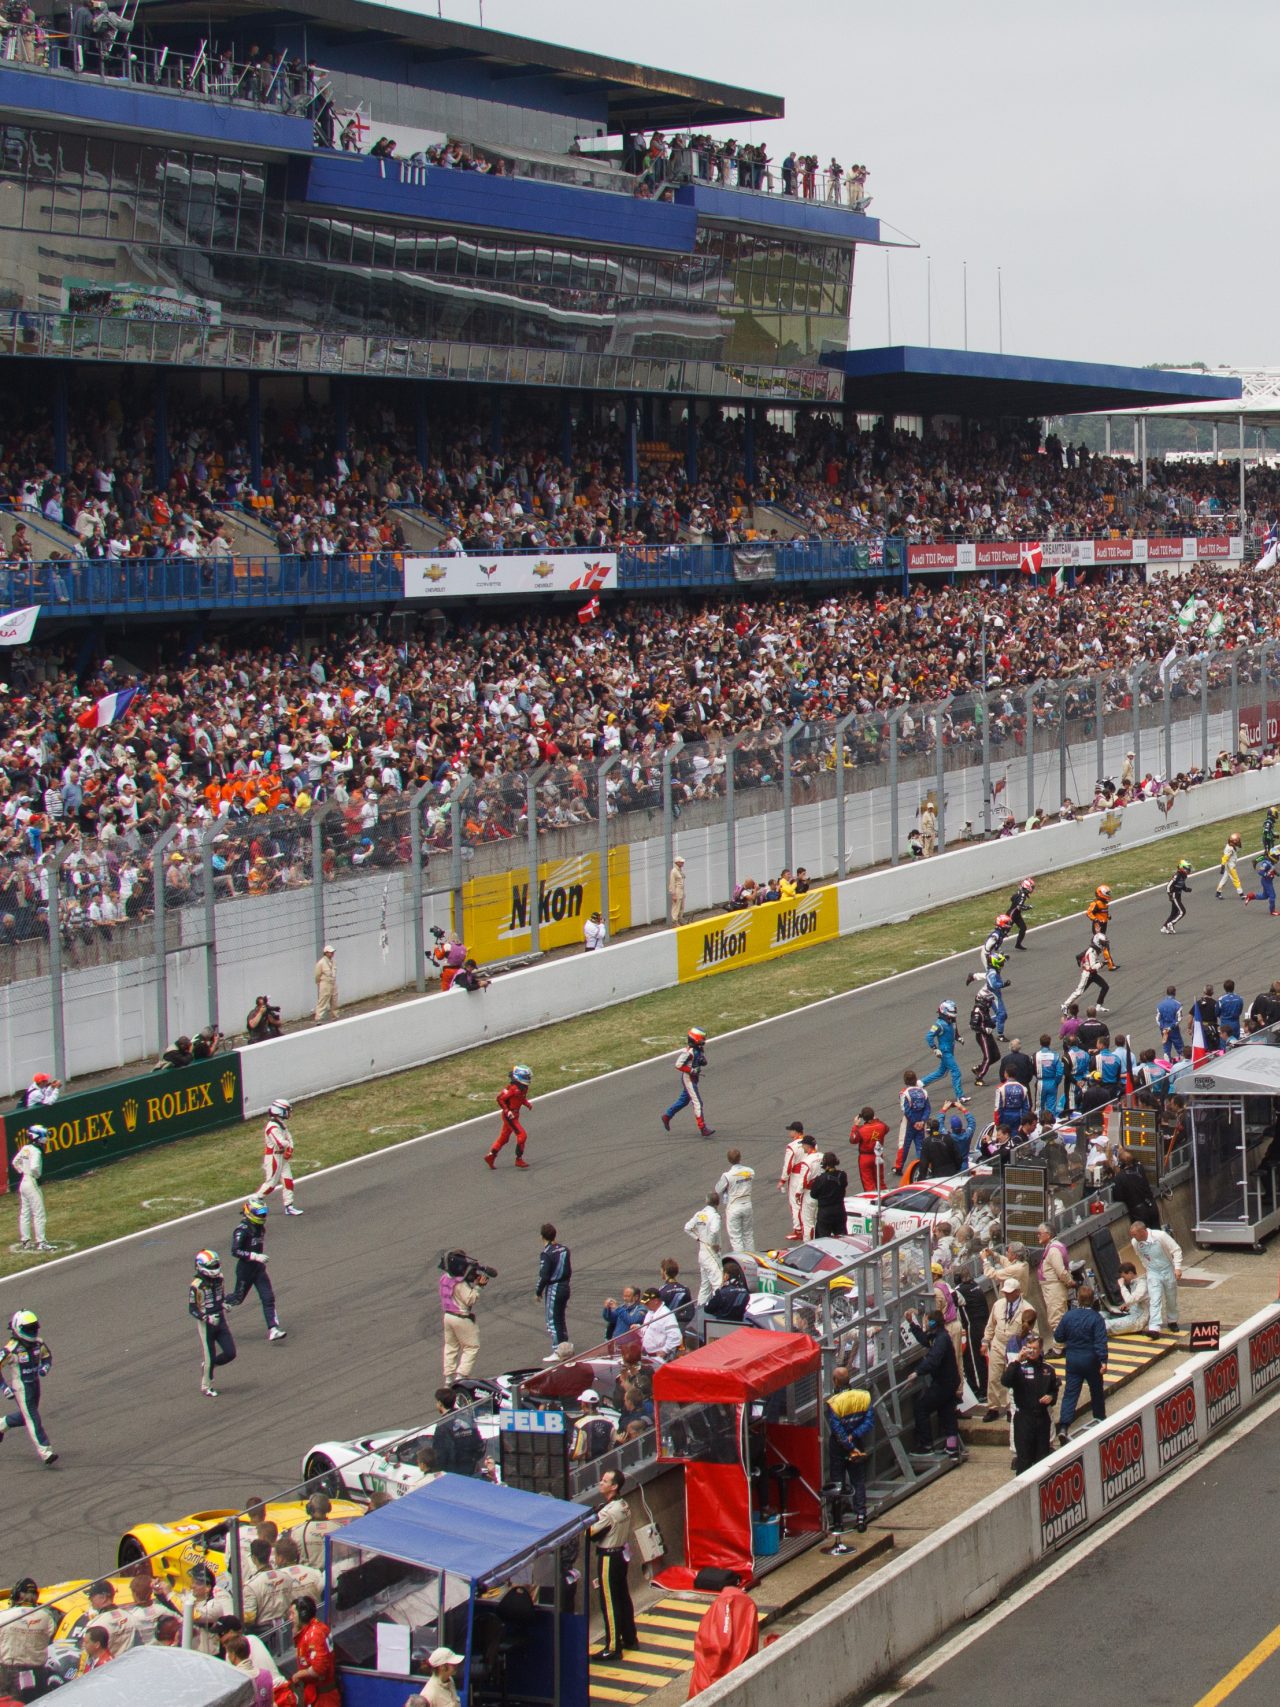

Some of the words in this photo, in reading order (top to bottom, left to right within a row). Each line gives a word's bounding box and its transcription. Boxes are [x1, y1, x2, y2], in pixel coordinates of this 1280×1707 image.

[911, 552, 925, 565] Audi
[926, 553, 936, 564] TDI
[937, 552, 955, 563] Power
[978, 551, 991, 563] Audi
[992, 551, 1001, 562] TDI
[1001, 551, 1019, 561] Power
[1097, 545, 1107, 557] Audi
[1108, 546, 1116, 557] TDI
[1117, 546, 1131, 557] Power
[1149, 545, 1160, 556] Audi
[1168, 544, 1182, 555] Power
[1199, 544, 1207, 554] Audi
[1215, 543, 1229, 553] Power
[509, 879, 583, 930] Nkon
[777, 909, 817, 943] Nikon
[703, 930, 747, 964] Nikon
[147, 1082, 214, 1124] ROLEX
[44, 1110, 116, 1154] ROLEX
[1192, 1325, 1219, 1337] AMR
[1204, 1353, 1239, 1406] MOTO
[500, 1410, 564, 1432] FELB
[1156, 1385, 1196, 1442] MOTO
[1099, 1422, 1143, 1481] MOTO
[1039, 1461, 1085, 1524] MOTO
